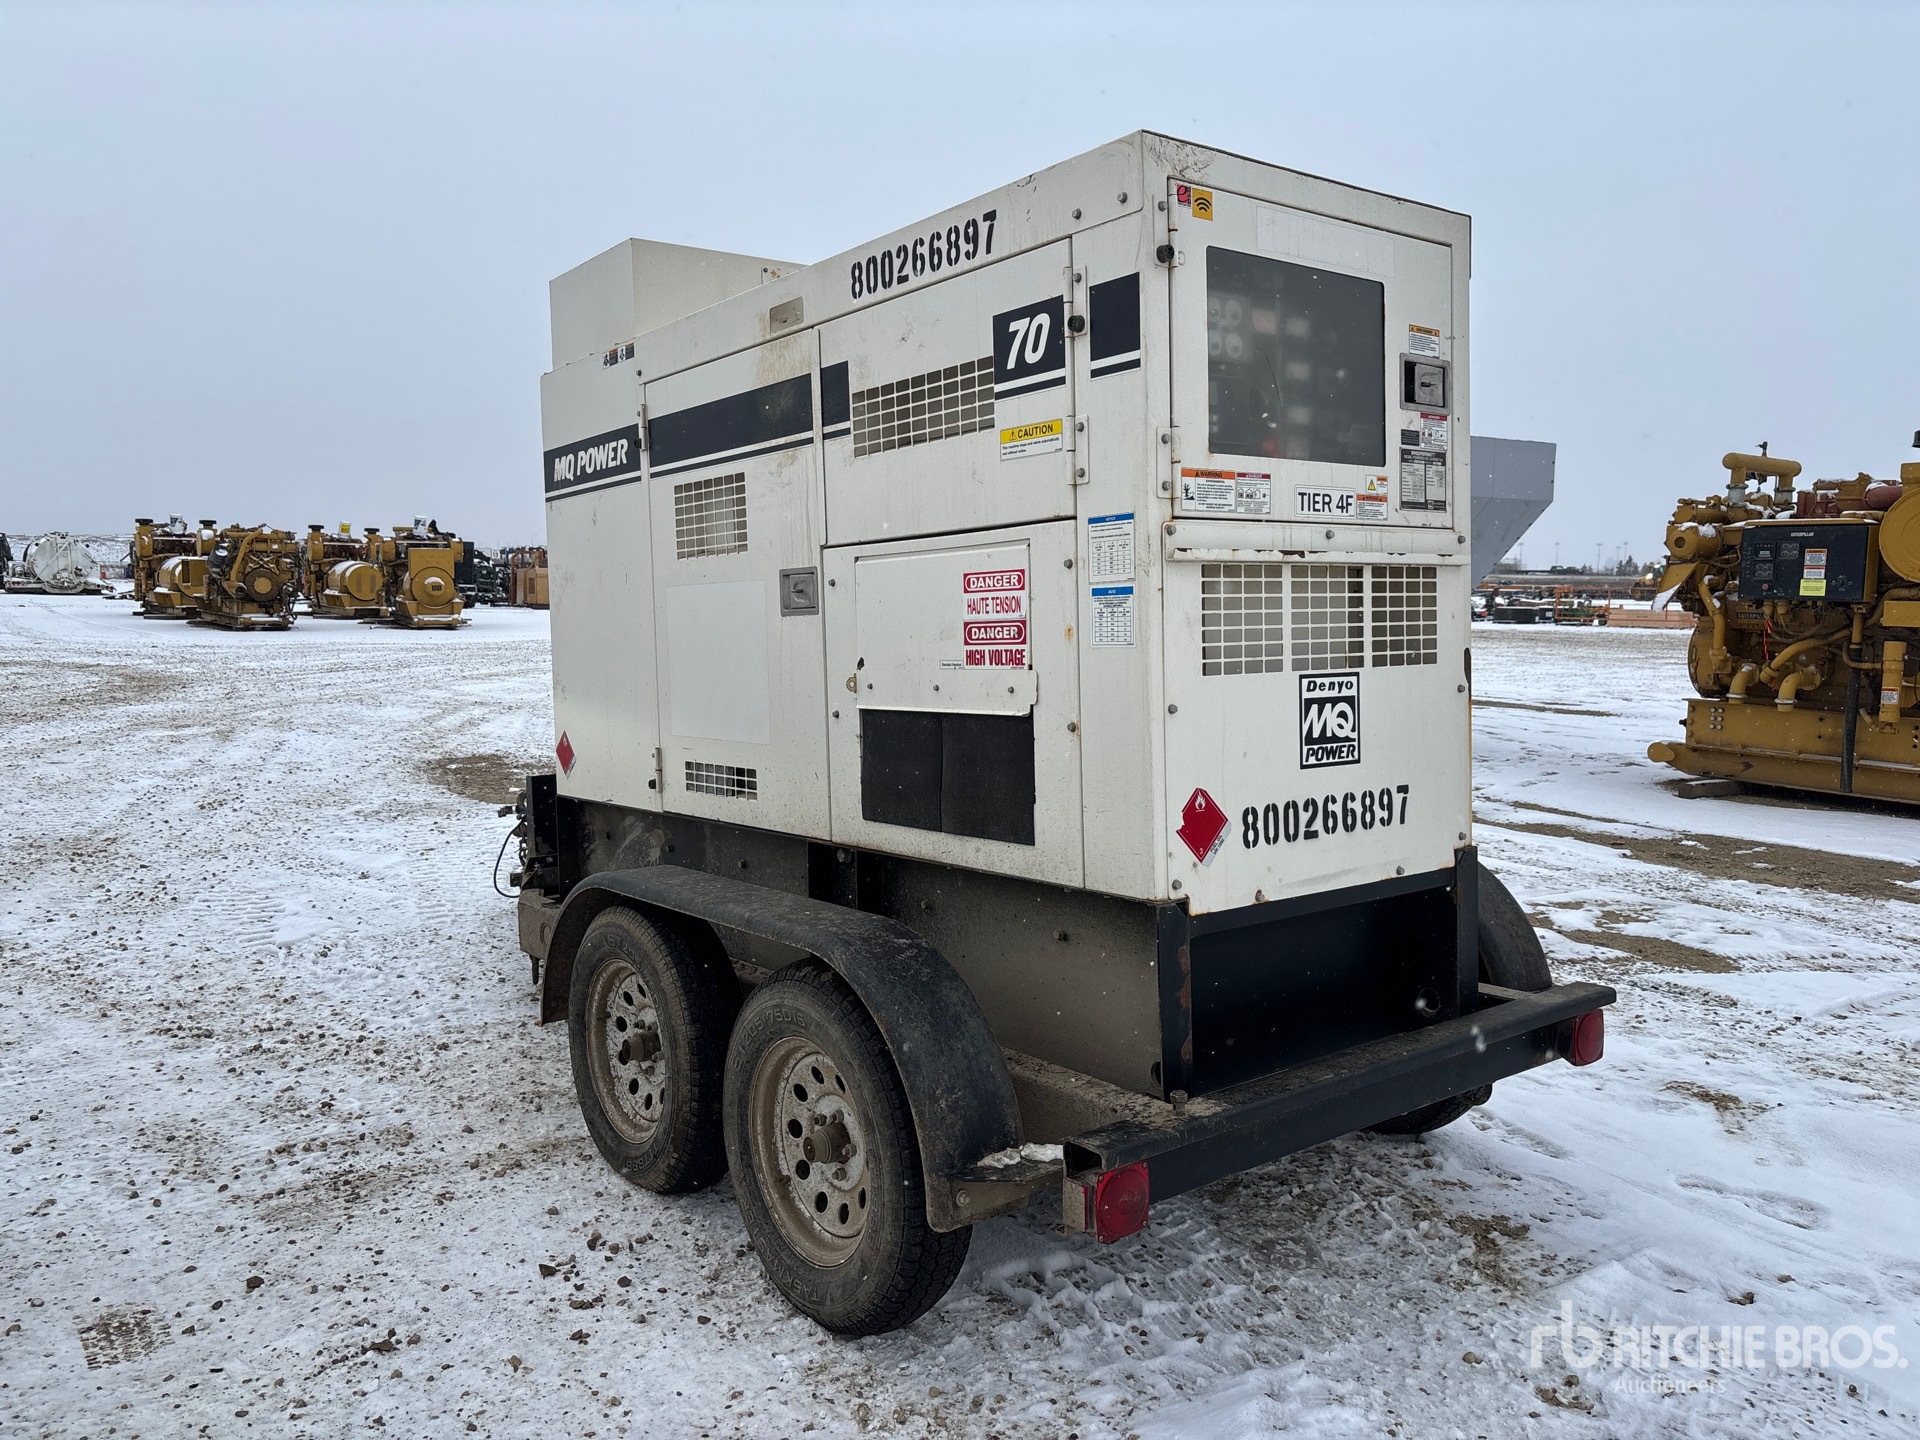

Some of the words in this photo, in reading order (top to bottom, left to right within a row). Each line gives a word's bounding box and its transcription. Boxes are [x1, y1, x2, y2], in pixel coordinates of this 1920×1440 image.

[851, 209, 997, 299] 800266897
[1006, 312, 1051, 370] 70
[1017, 423, 1053, 439] CAUTION
[554, 453, 575, 482] MQ
[577, 438, 628, 476] POWER
[1298, 492, 1332, 513] TIER
[1336, 494, 1354, 514] 4F
[969, 574, 1018, 589] DANGER
[967, 597, 989, 615] HAUTE
[991, 595, 1021, 614] TENSION
[971, 626, 1018, 640] DANGER
[965, 649, 985, 666] HIGH
[988, 648, 1025, 667] VOLTAGE
[1306, 680, 1354, 694] Denyo
[1304, 702, 1357, 739] MQ
[1305, 743, 1357, 763] POWER
[1242, 784, 1409, 849] 800266897
